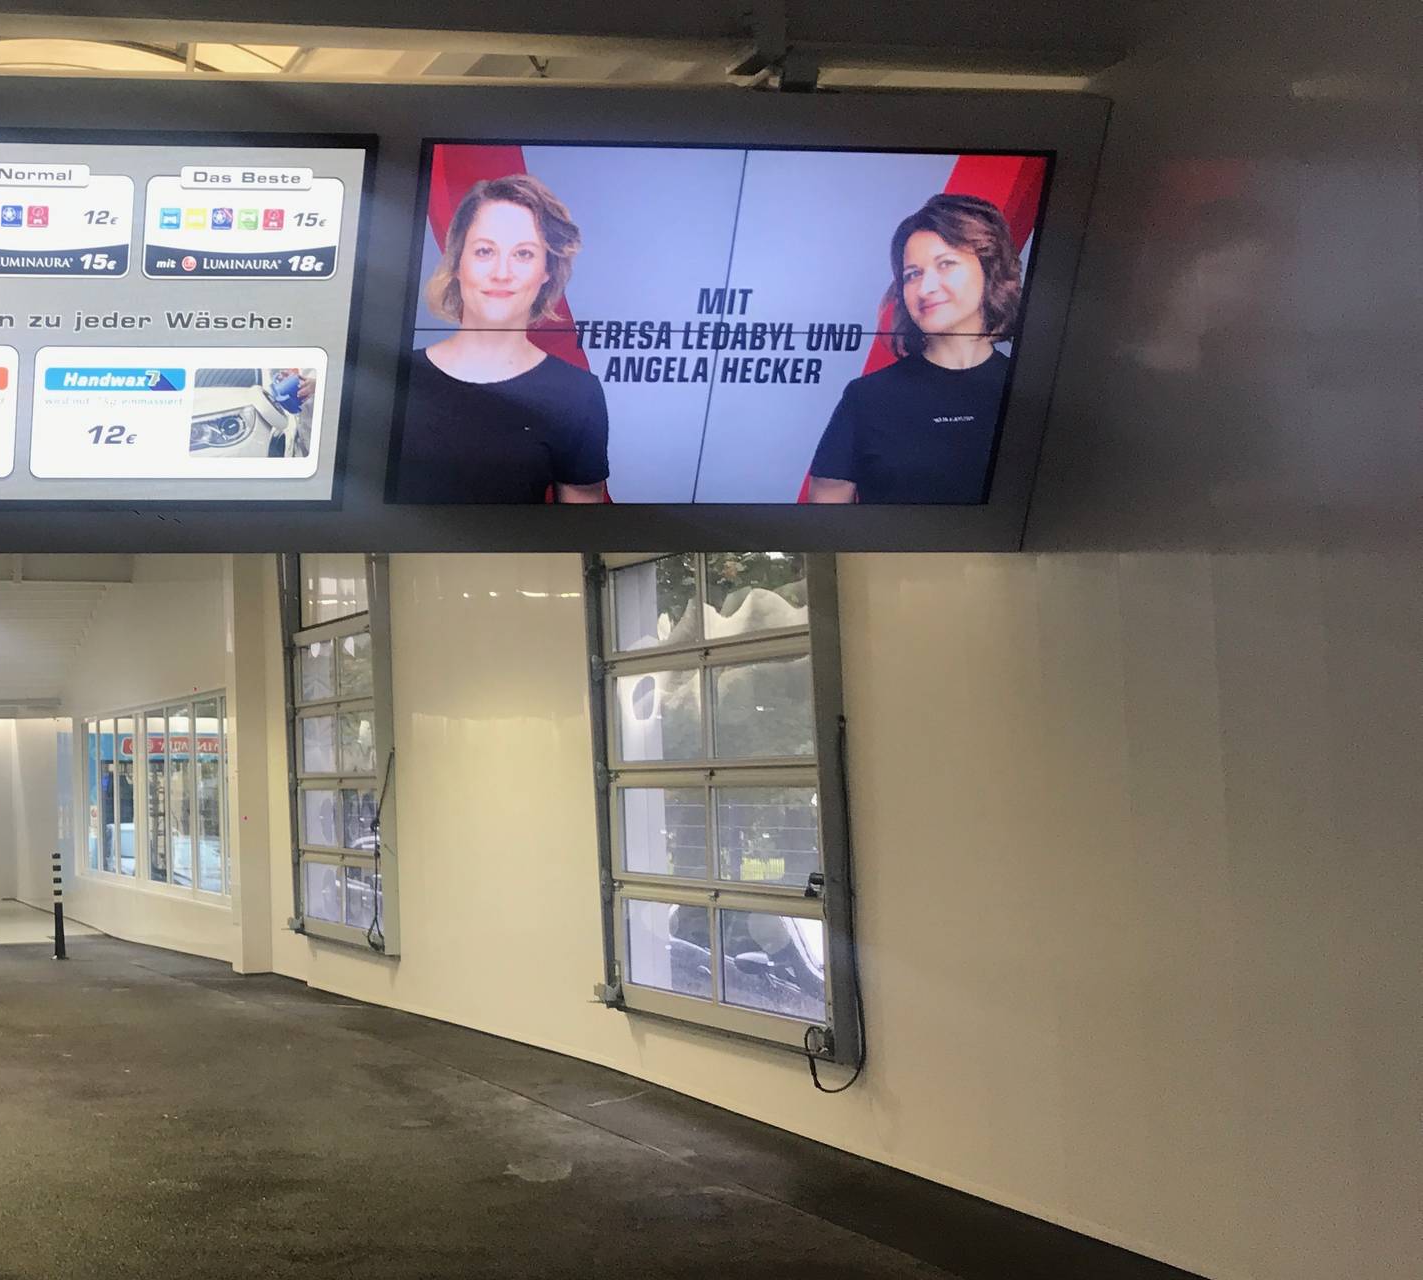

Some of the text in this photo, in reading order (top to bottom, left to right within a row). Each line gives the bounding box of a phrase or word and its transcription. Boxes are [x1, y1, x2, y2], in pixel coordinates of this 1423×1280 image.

[193, 171, 302, 185] Das Beste
[83, 210, 119, 226] 12€
[292, 212, 328, 228] 15€
[80, 253, 117, 271] 15€
[156, 259, 177, 270] mit
[288, 254, 324, 273] 18€
[697, 287, 753, 315] MIT
[29, 314, 61, 329] zu
[74, 312, 152, 331] jeder
[166, 311, 294, 330] Wäsche:
[575, 319, 863, 352] TERESA LEDABYL UND
[604, 356, 822, 384] ANGELA HECKER
[87, 425, 137, 445] 12€
